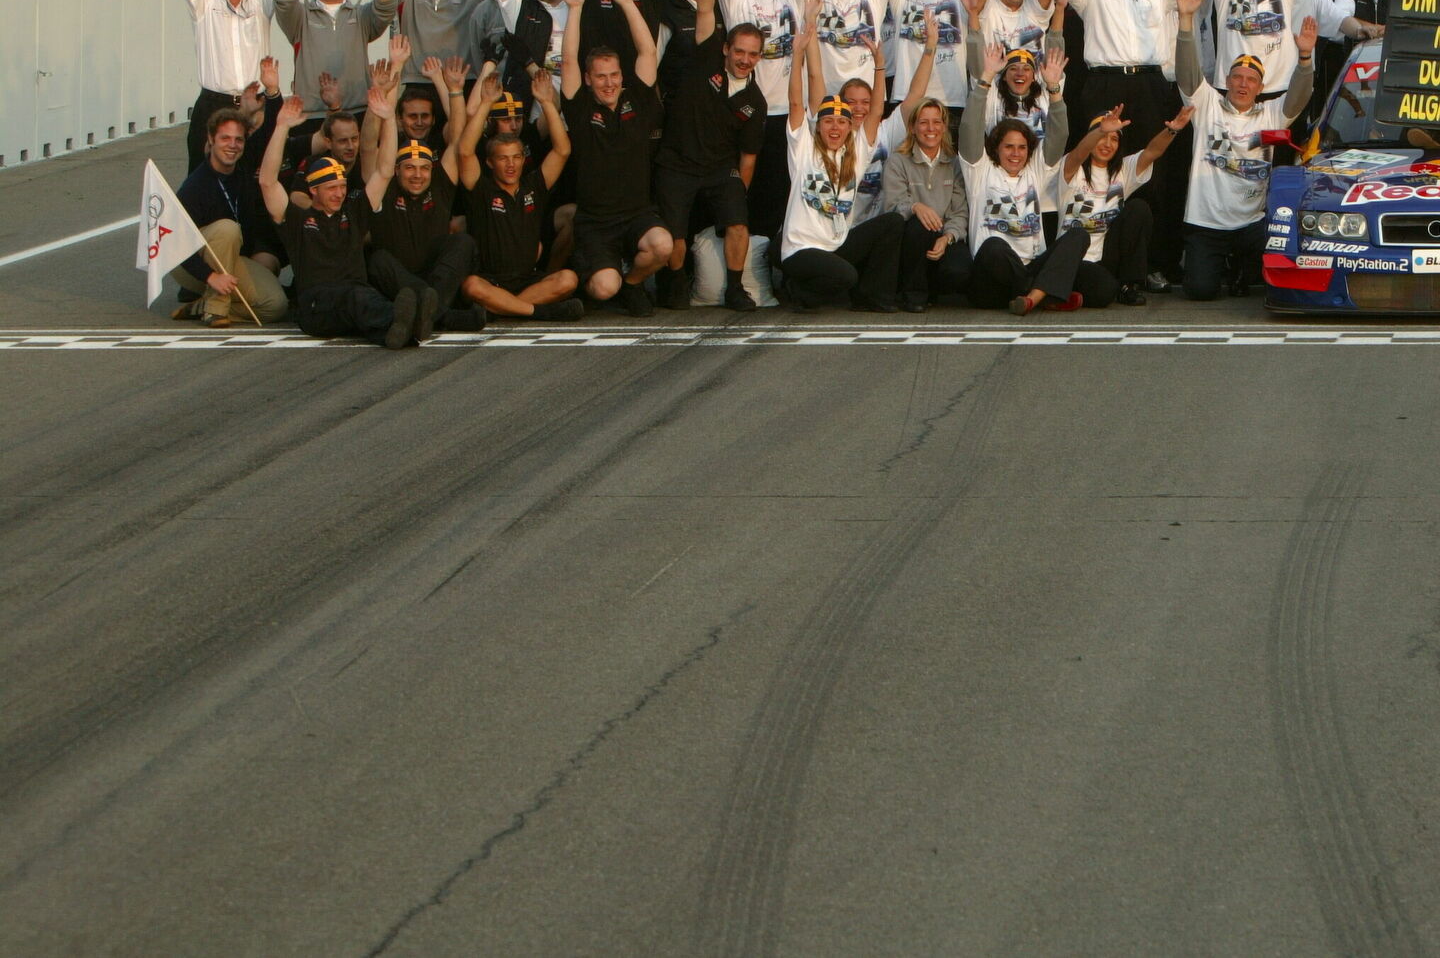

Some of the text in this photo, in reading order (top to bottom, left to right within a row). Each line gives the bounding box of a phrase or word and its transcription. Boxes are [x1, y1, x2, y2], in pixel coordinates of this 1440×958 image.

[1265, 236, 1289, 249] ABT
[1306, 239, 1369, 254] DUNLOP
[1304, 257, 1328, 267] Castrol
